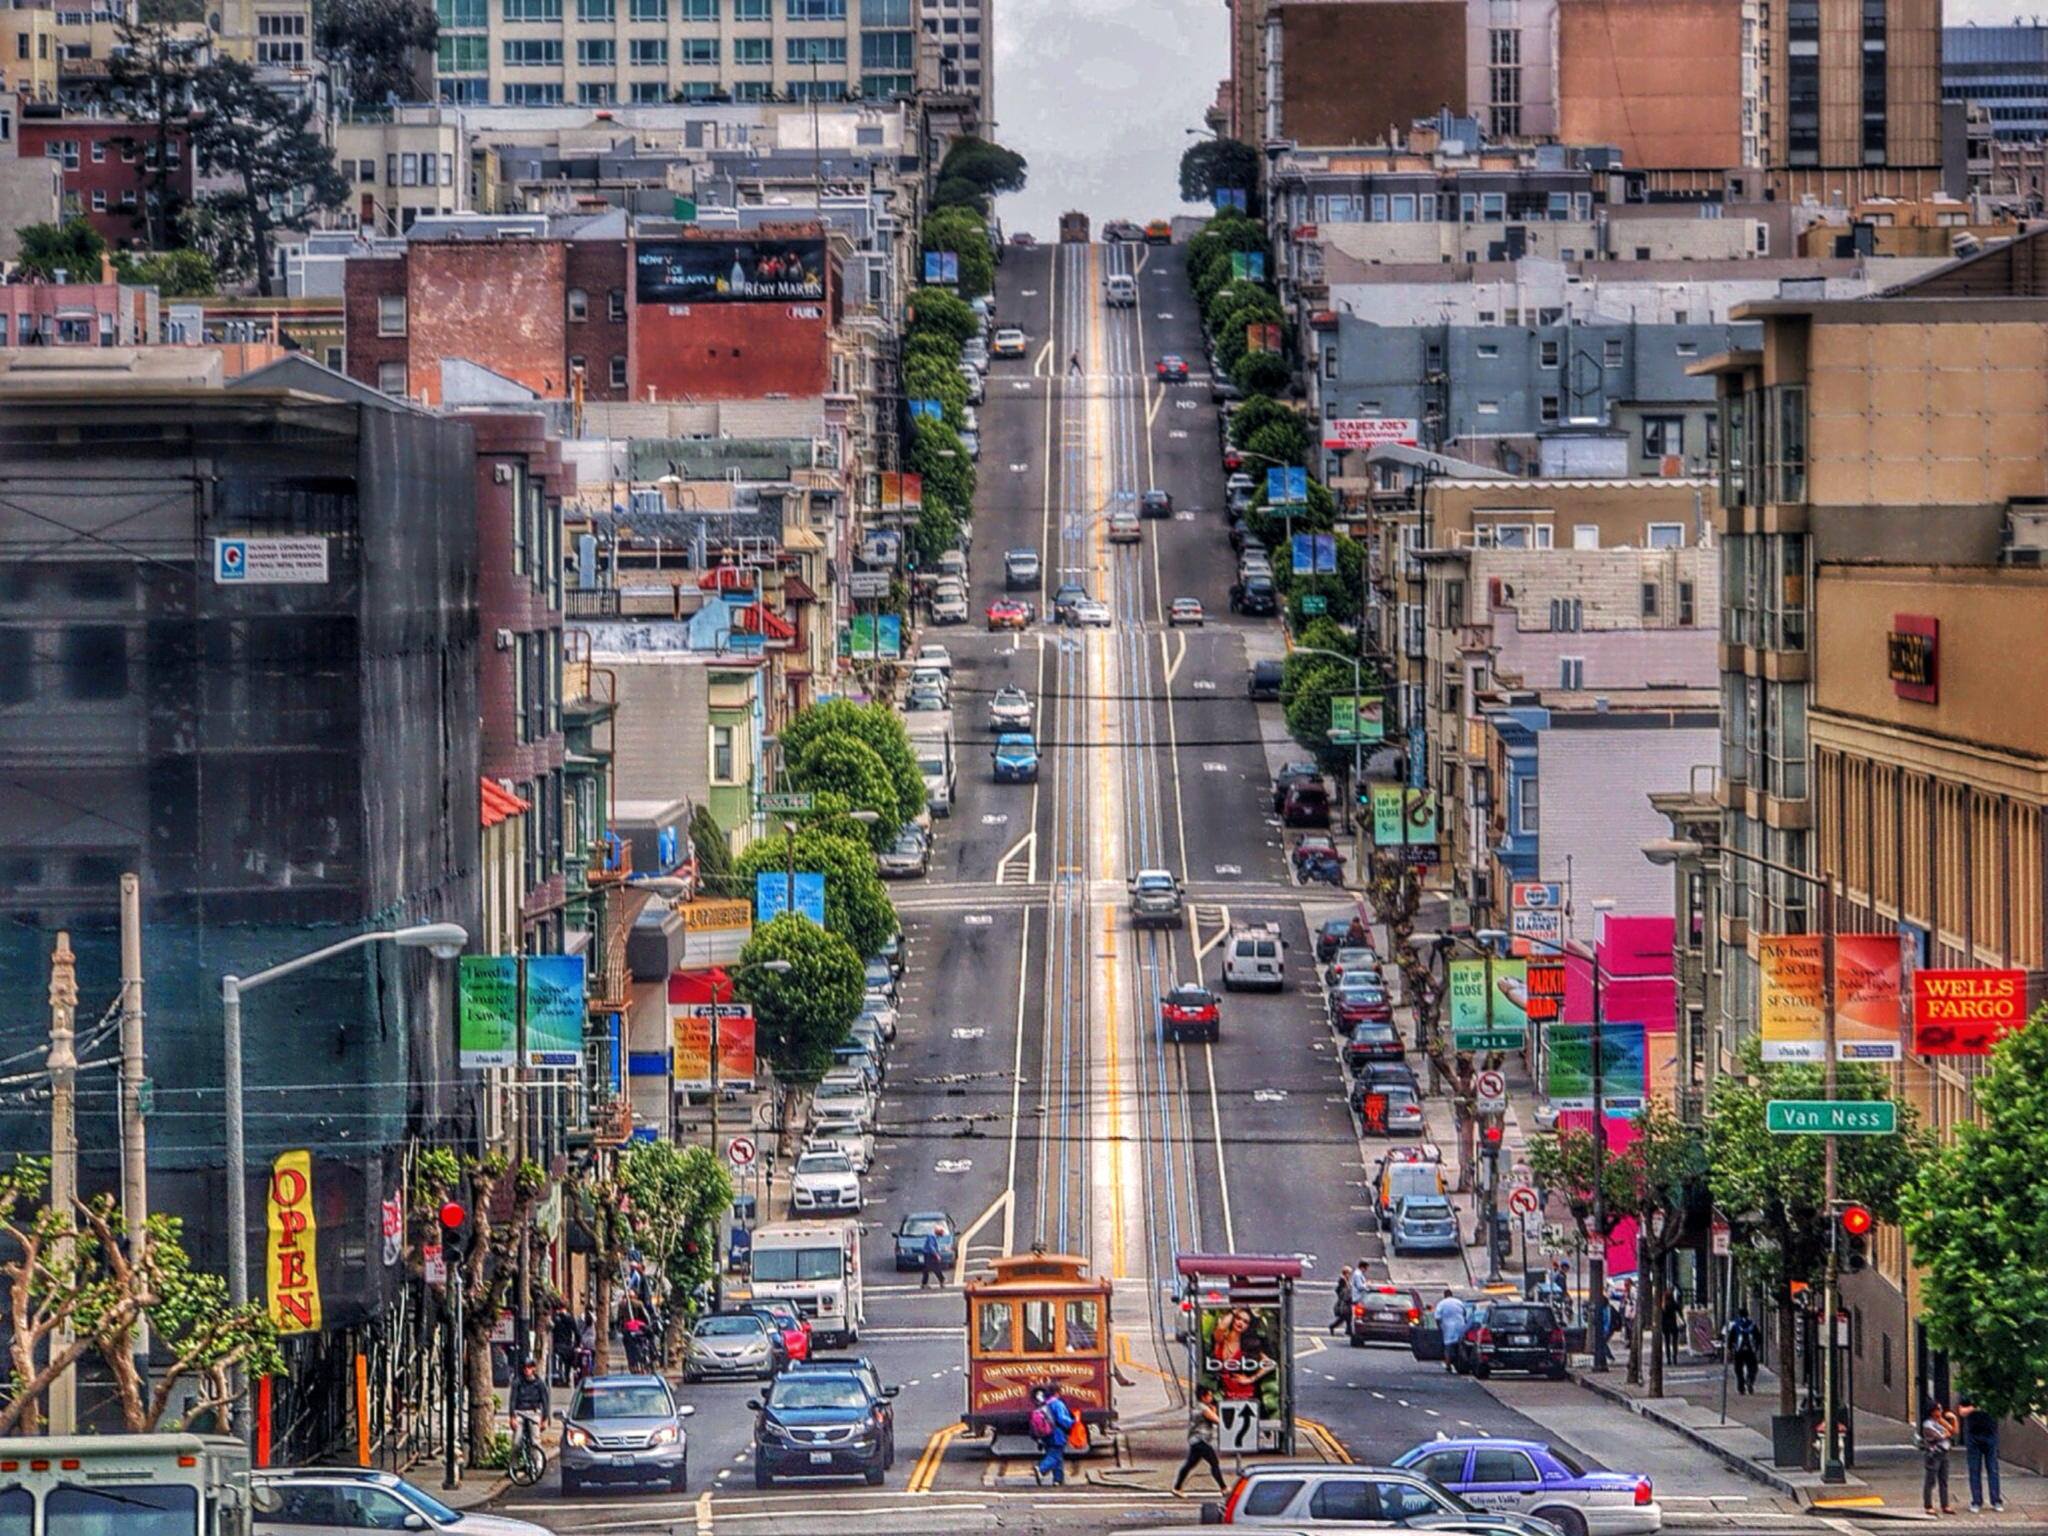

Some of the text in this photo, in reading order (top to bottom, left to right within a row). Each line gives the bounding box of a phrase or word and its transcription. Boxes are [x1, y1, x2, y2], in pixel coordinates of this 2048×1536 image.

[665, 275, 716, 285] PINEAPPLE
[744, 281, 822, 296] RÉMY MARTIN
[1176, 400, 1197, 409] NO
[1332, 421, 1375, 430] TRADER
[1339, 430, 1361, 439] CVS
[1377, 808, 1399, 817] CLOSE
[1516, 922, 1558, 930] MARKET
[1789, 944, 1819, 958] heart
[1785, 963, 1818, 975] SOUL
[1453, 971, 1482, 983] BAY UP
[1453, 985, 1483, 996] CLOSE
[1924, 980, 2014, 999] WELLS
[1927, 999, 2014, 1018] FARGO
[1471, 1036, 1508, 1047] Polk
[1783, 1108, 1880, 1126] Van Ness
[272, 1168, 314, 1330] OPEN
[1049, 1362, 1094, 1377] California
[1206, 1356, 1277, 1372] bebe
[991, 1386, 1025, 1401] Market
[1061, 1384, 1097, 1399] Streets
[1498, 1494, 1521, 1505] Valley
